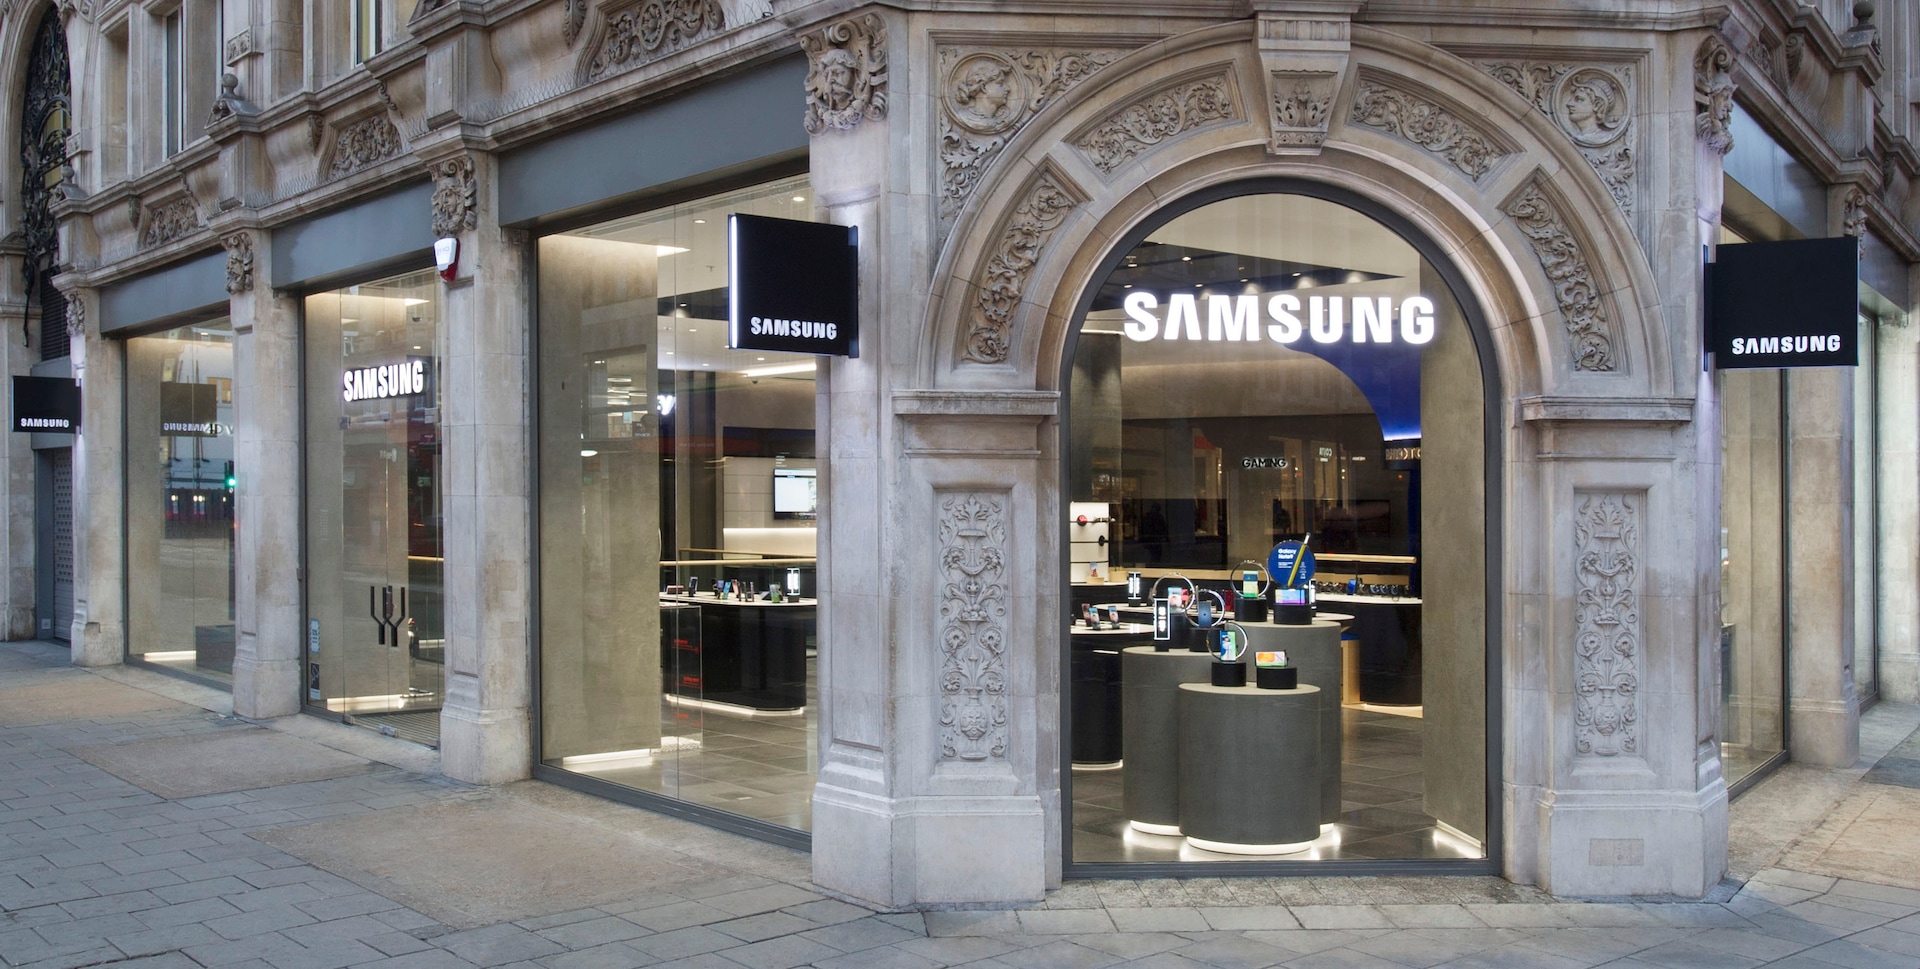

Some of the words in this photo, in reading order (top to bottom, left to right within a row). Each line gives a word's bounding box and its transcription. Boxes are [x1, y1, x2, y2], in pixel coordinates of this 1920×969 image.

[750, 316, 837, 340] SAMSUNG
[1123, 290, 1435, 345] SAMSUNG
[1731, 335, 1841, 355] SAMSUNG
[343, 360, 424, 402] SAMSUNG
[20, 417, 70, 429] SAMSUNG
[1242, 457, 1287, 469] GAMING
